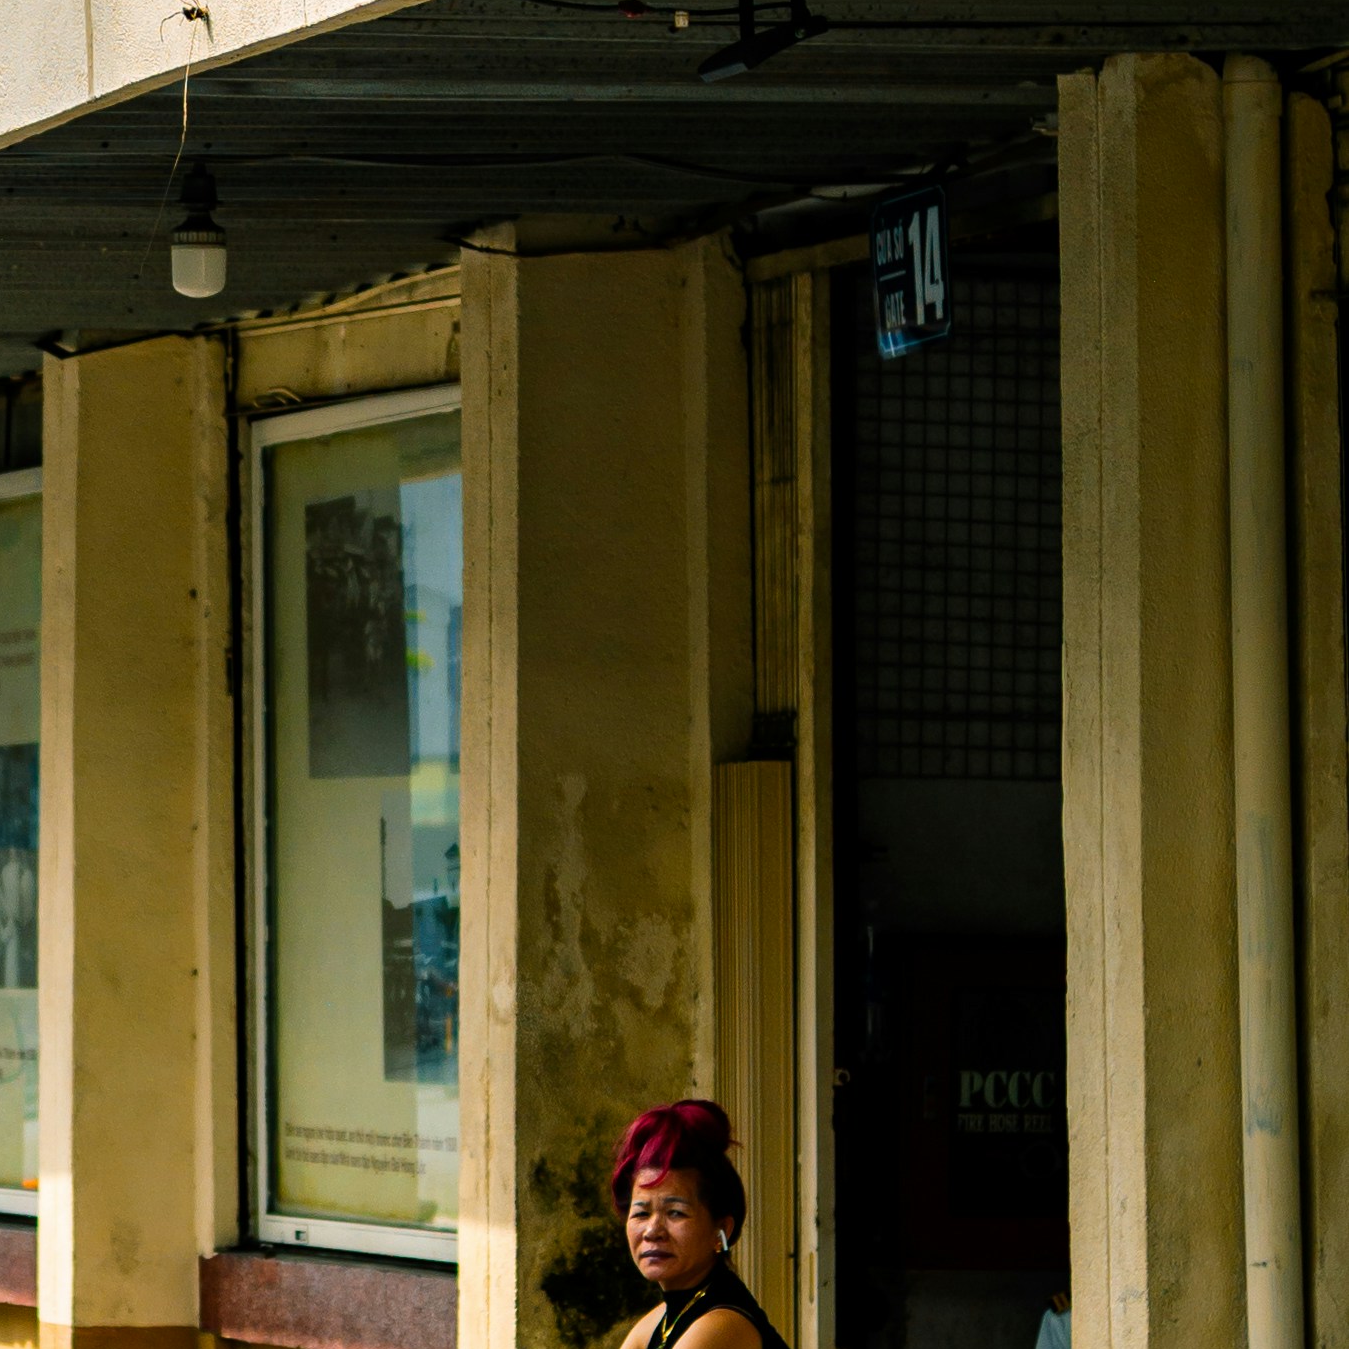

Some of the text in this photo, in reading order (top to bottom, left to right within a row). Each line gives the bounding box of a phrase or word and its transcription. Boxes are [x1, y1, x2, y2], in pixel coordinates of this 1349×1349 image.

[907, 204, 945, 326] 14
[884, 289, 907, 331] GATE
[957, 1069, 1056, 1110] PCCC
[956, 1113, 1056, 1134] FIRE HOSE REEL
